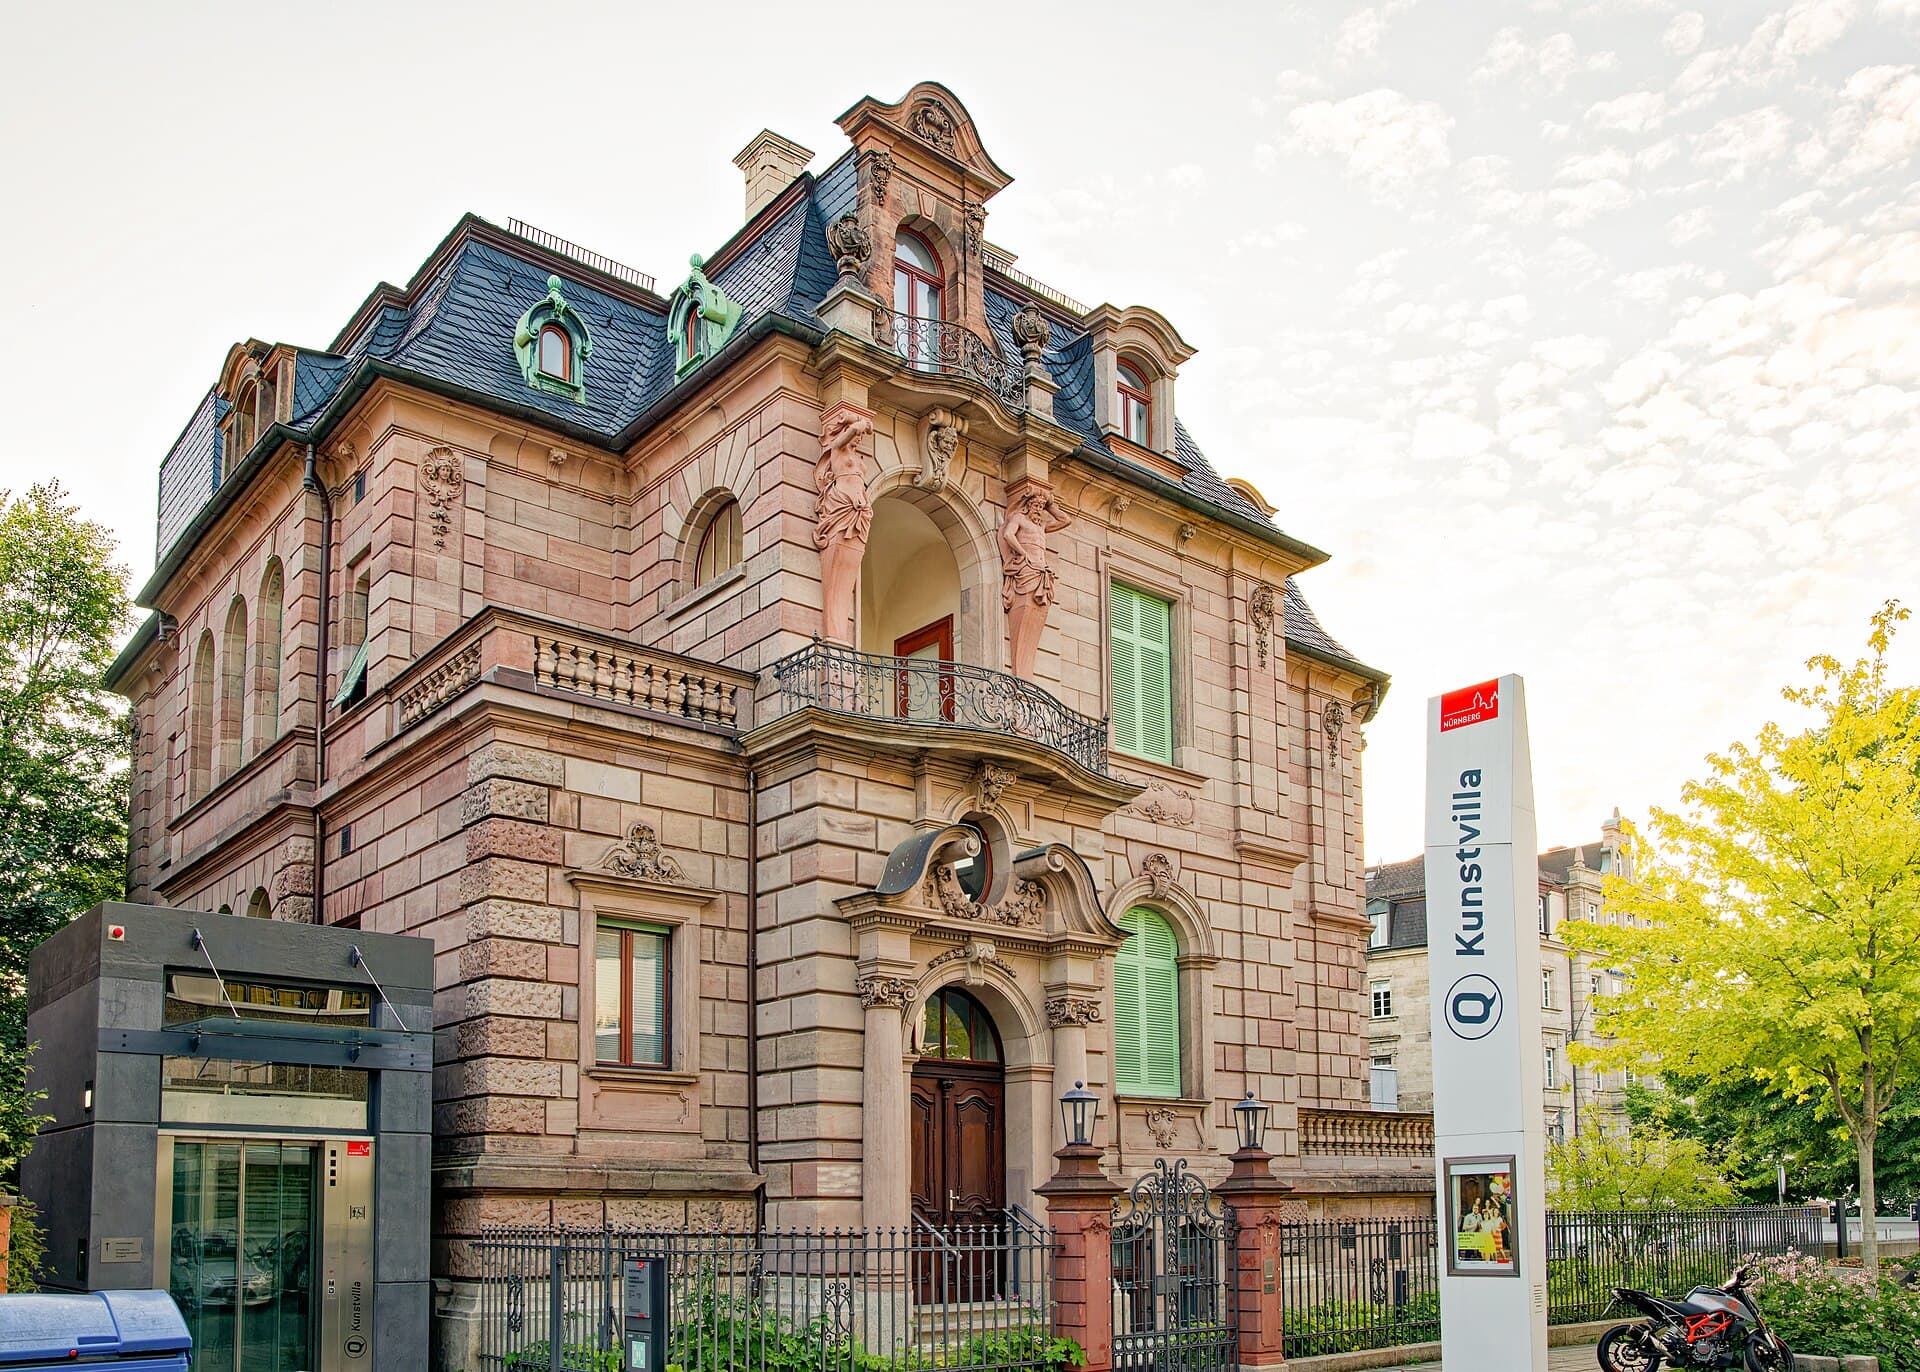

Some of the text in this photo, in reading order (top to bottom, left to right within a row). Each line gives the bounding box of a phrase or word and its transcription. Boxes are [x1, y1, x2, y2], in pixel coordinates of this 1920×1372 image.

[1443, 711, 1481, 729] NÜRNBERG
[1452, 768, 1497, 1025] Q Kunstvilla
[1263, 1232, 1274, 1245] 17
[347, 1281, 366, 1353] Q Kunstvilla
